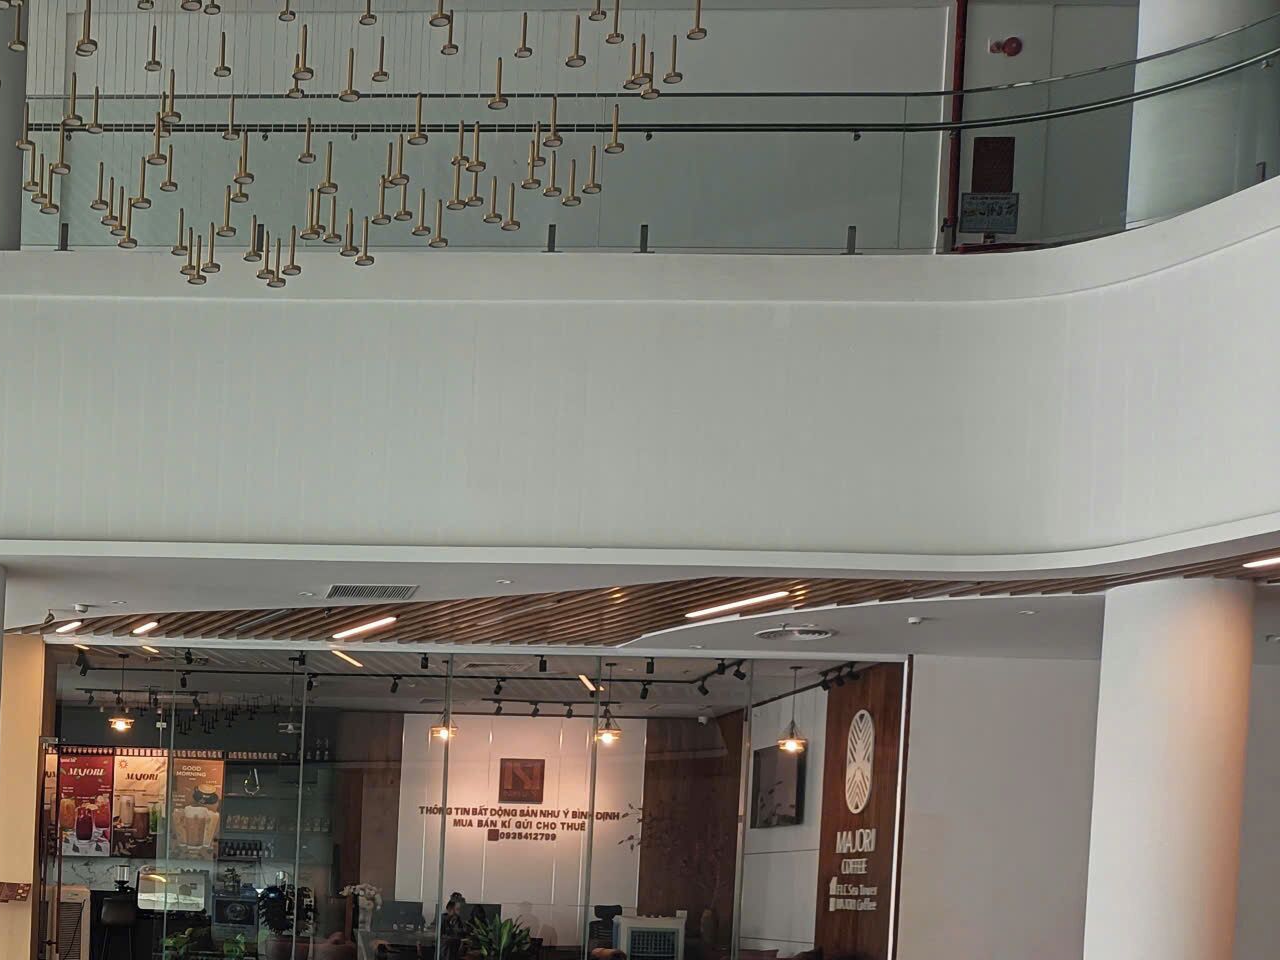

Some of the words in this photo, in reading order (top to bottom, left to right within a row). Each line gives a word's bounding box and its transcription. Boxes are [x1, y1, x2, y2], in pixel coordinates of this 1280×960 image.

[67, 767, 105, 776] MAJORI
[125, 772, 159, 780] MAJORI
[454, 807, 470, 816] TIN
[471, 804, 489, 816] BẤT
[489, 806, 517, 819] ĐỘNG
[518, 806, 538, 818] SẢN
[539, 809, 561, 819] NHƯ
[563, 808, 570, 818] Ý
[571, 808, 595, 820] BÌN
[595, 810, 620, 822] ĐỊNH
[453, 818, 473, 828] MUA
[477, 817, 497, 828] BÁN
[501, 818, 513, 829] KÍ
[515, 819, 532, 830] GỬI
[536, 821, 557, 831] CHO
[560, 820, 586, 832] THUÊ
[835, 829, 877, 853] MAJORI
